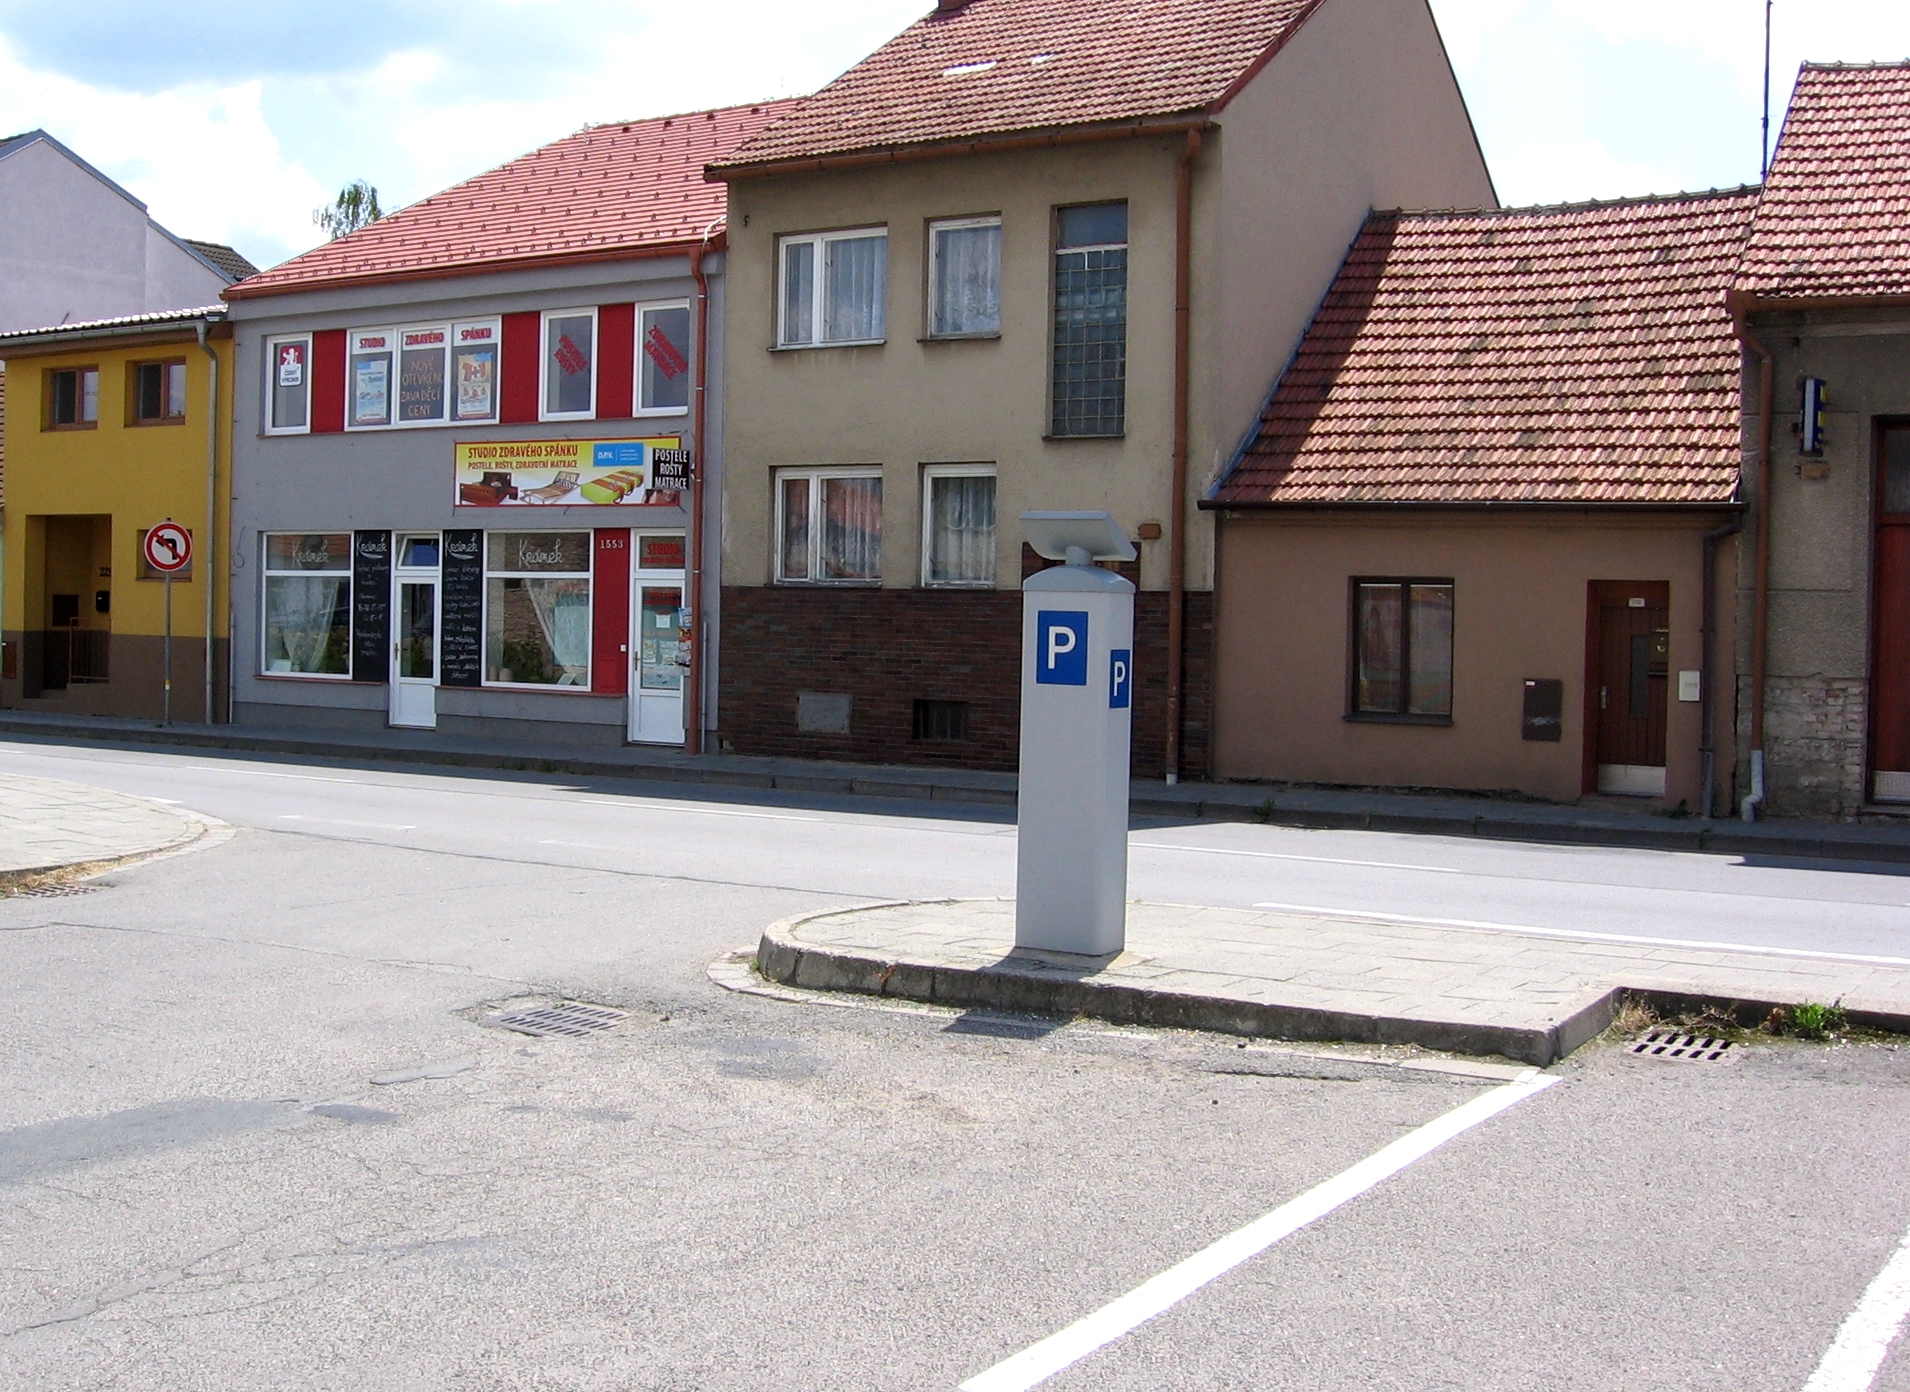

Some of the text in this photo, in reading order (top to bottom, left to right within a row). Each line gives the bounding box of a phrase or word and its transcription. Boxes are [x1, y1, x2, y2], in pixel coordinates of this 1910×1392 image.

[359, 337, 386, 348] STUDIO
[468, 443, 578, 458] STUDIO ZDRAVÉHO SPÁNKU
[655, 449, 688, 462] POSTELE
[660, 461, 683, 475] ROŠTY
[655, 476, 687, 489] MATRACE
[600, 540, 624, 549] 1553
[1047, 625, 1077, 669] P
[1113, 661, 1126, 697] P
